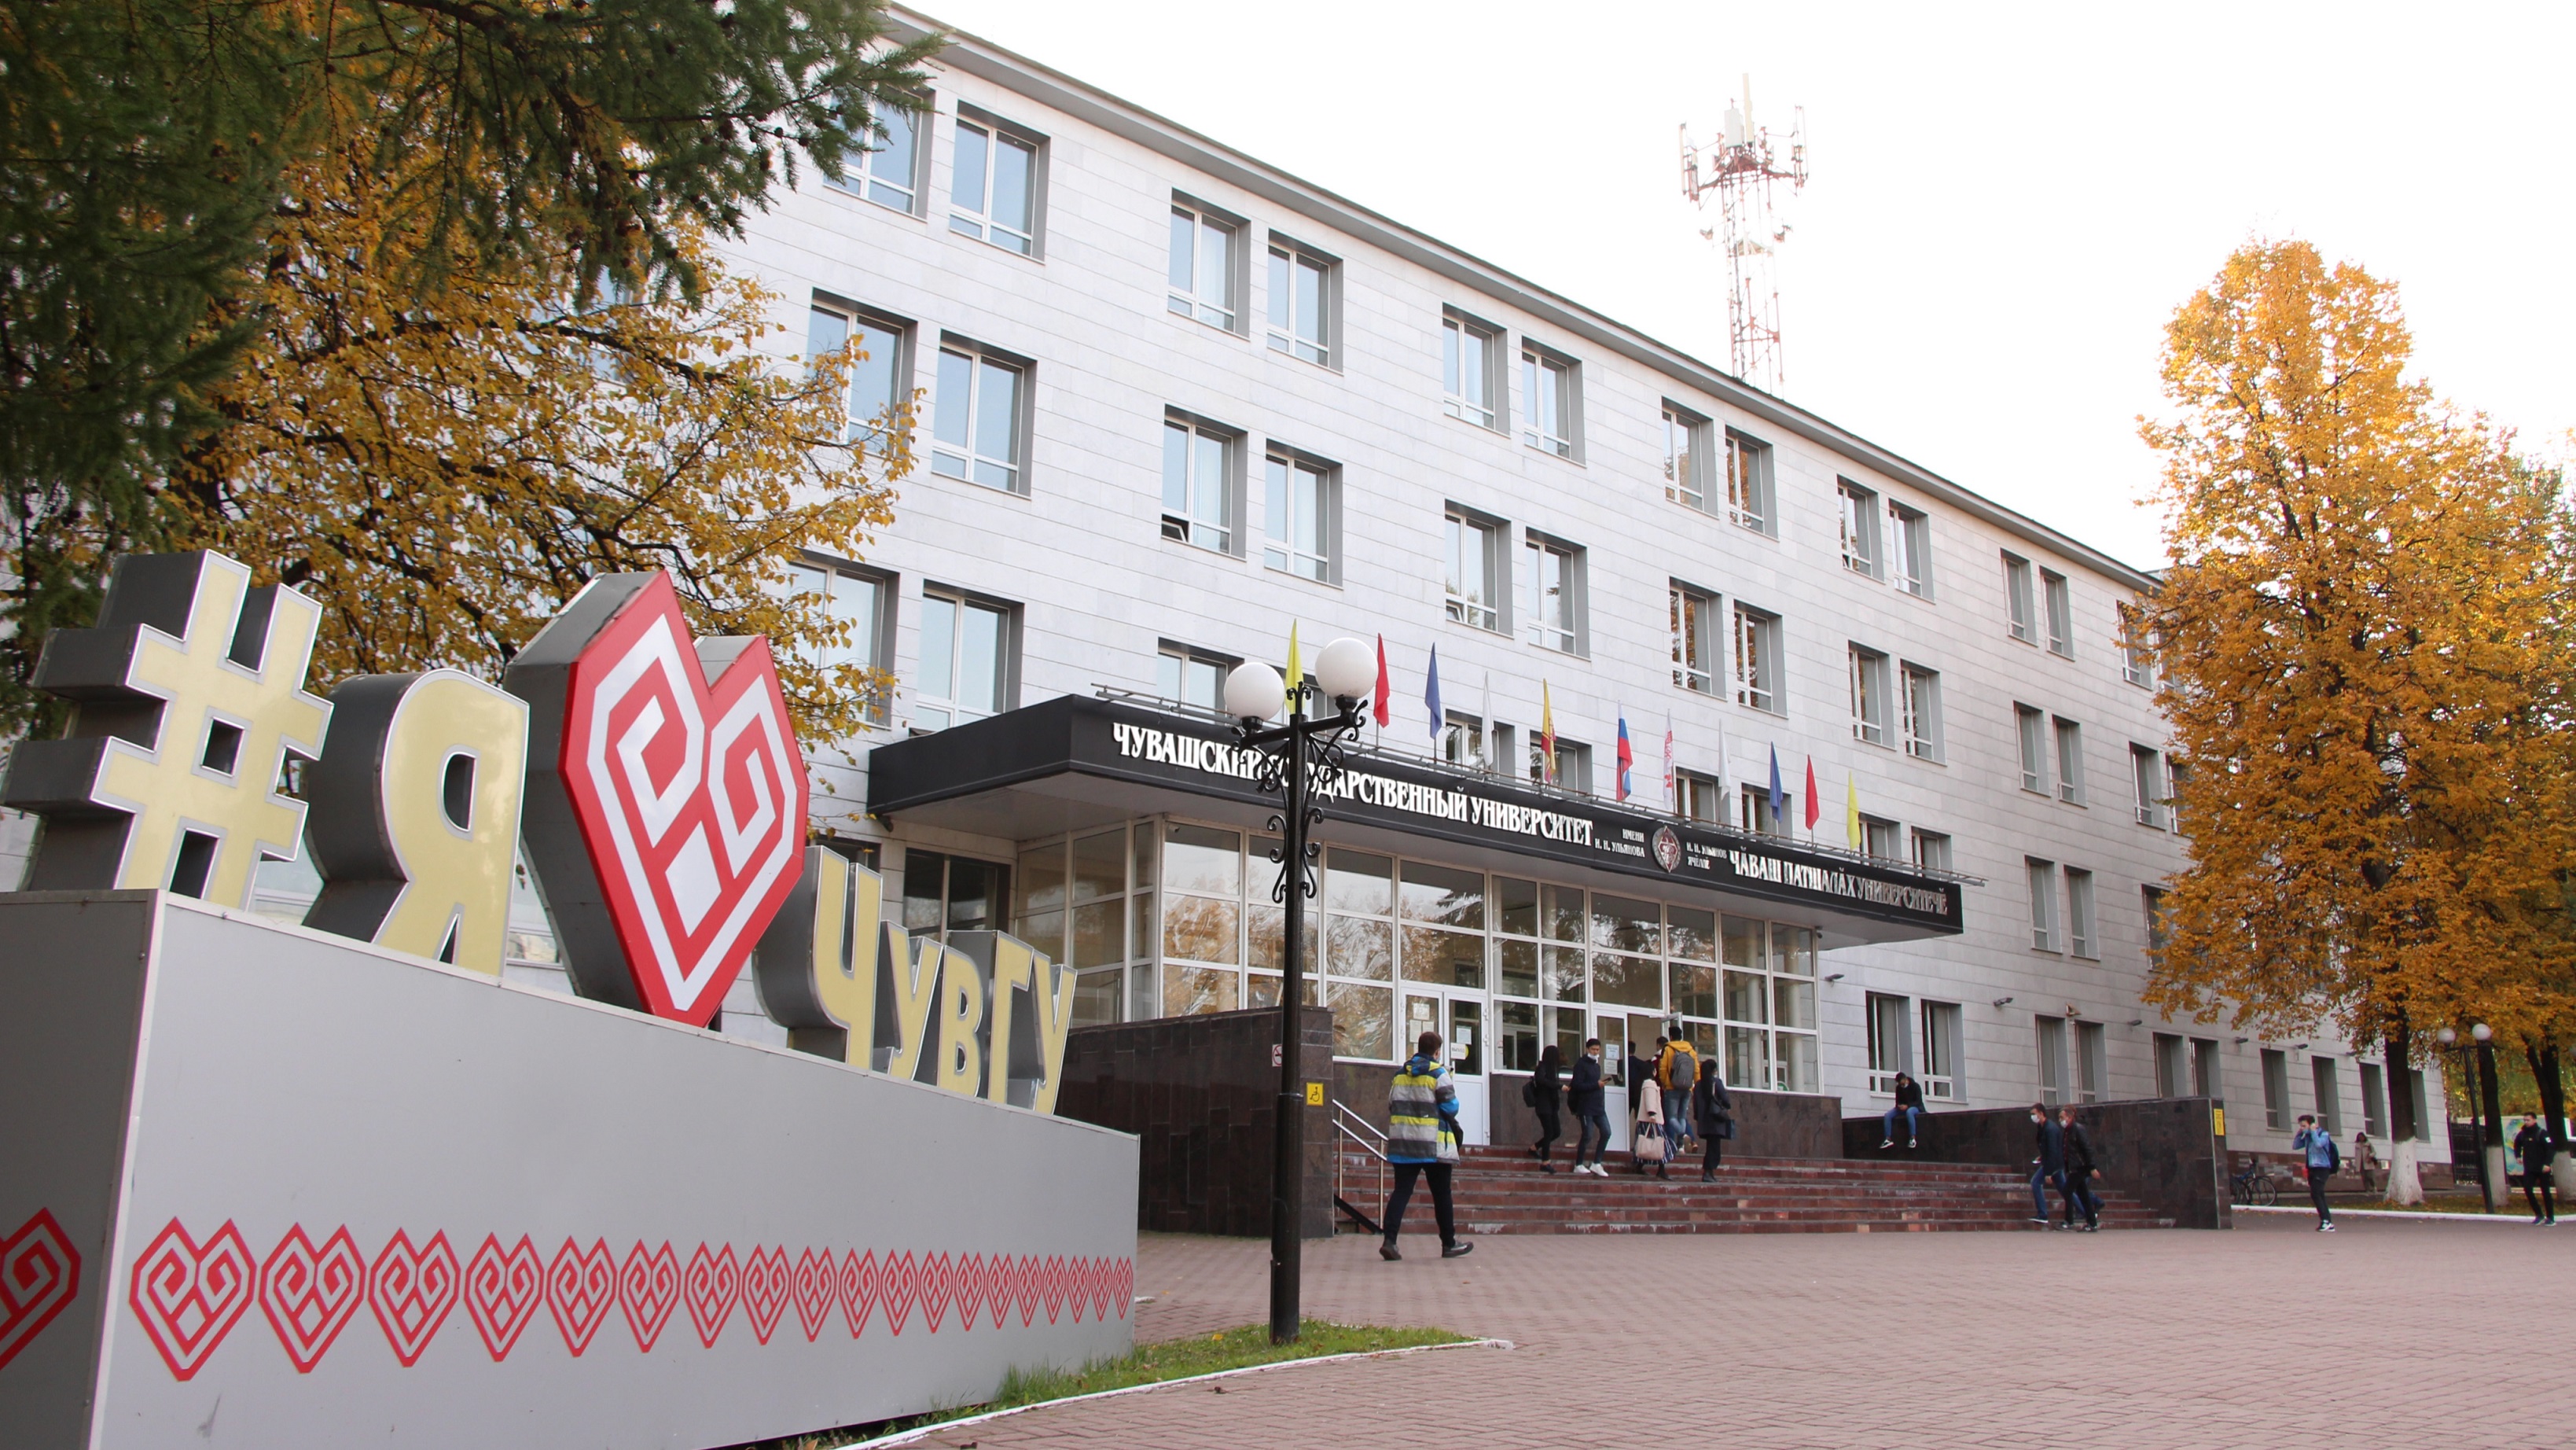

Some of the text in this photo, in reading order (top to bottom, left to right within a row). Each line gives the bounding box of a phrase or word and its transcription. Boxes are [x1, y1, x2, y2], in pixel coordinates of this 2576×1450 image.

[1469, 796, 1593, 847] УНИВЕРСИТЕТ
[1622, 828, 1645, 843] ИМЕНИ
[1611, 841, 1645, 858] УЛЬЯНОВА
[1701, 845, 1727, 859] УЛЬЯНОВ
